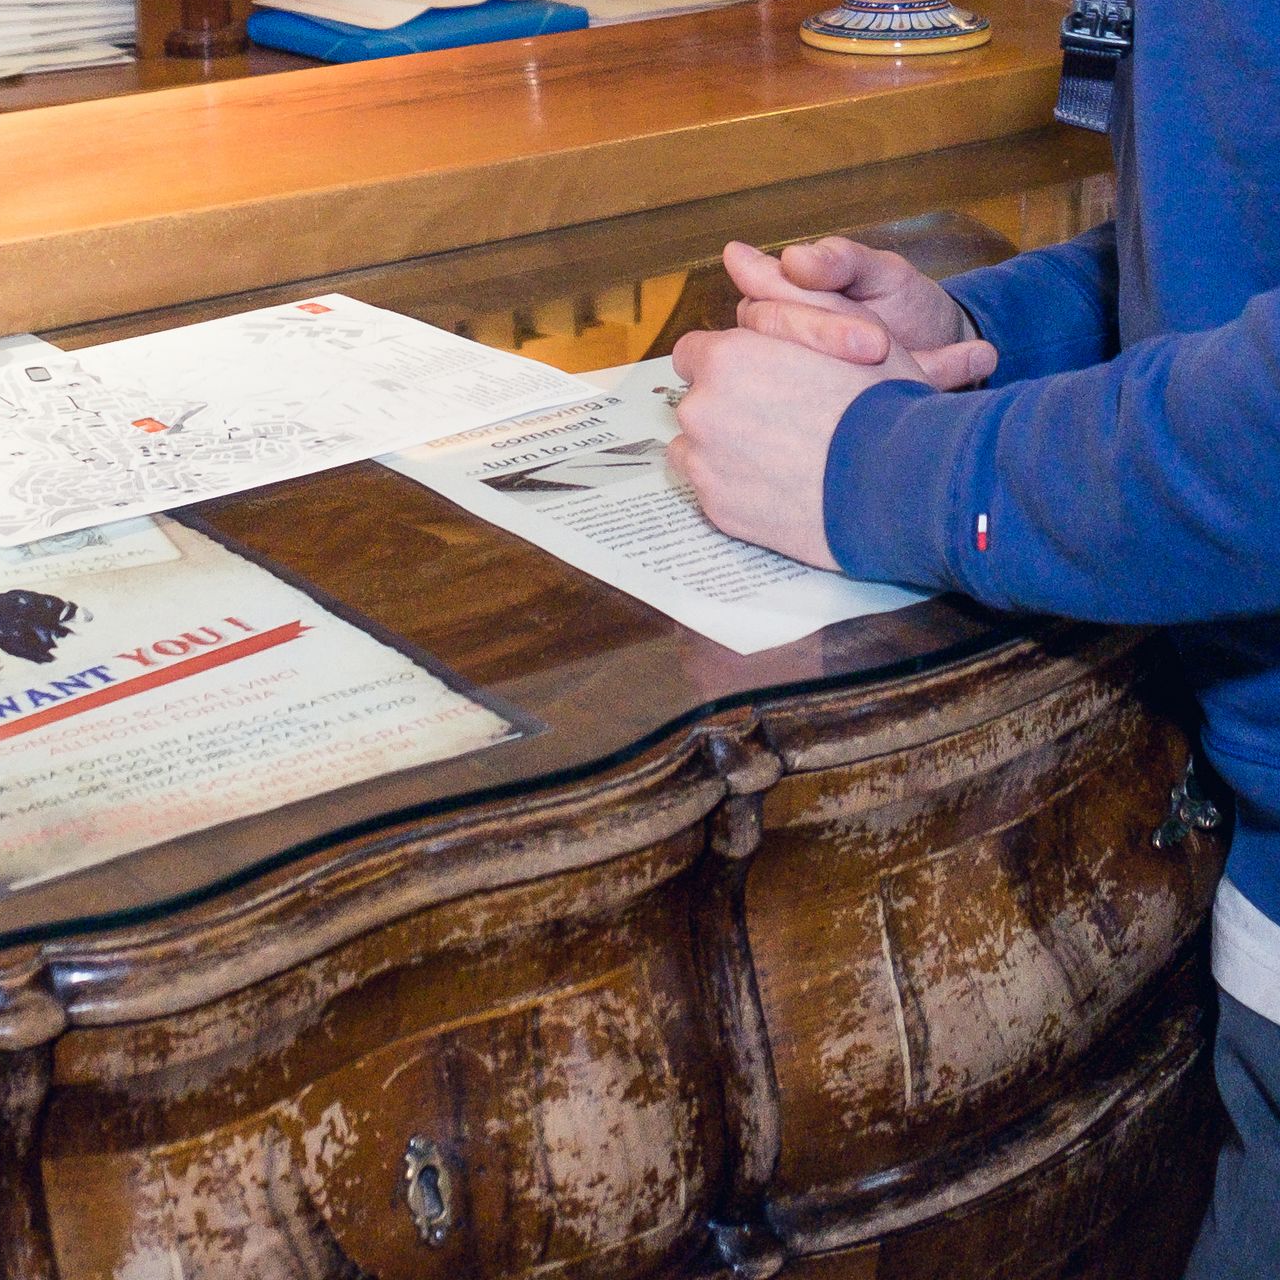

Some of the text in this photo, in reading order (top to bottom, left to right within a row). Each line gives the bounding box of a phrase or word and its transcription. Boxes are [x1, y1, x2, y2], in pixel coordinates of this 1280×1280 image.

[512, 399, 604, 426] leaving
[605, 395, 621, 405] a
[491, 415, 605, 449] comment
[539, 444, 568, 456] to
[572, 431, 616, 448] us!!
[117, 626, 223, 667] YOU
[224, 616, 255, 632] !
[234, 668, 306, 689] VINCI
